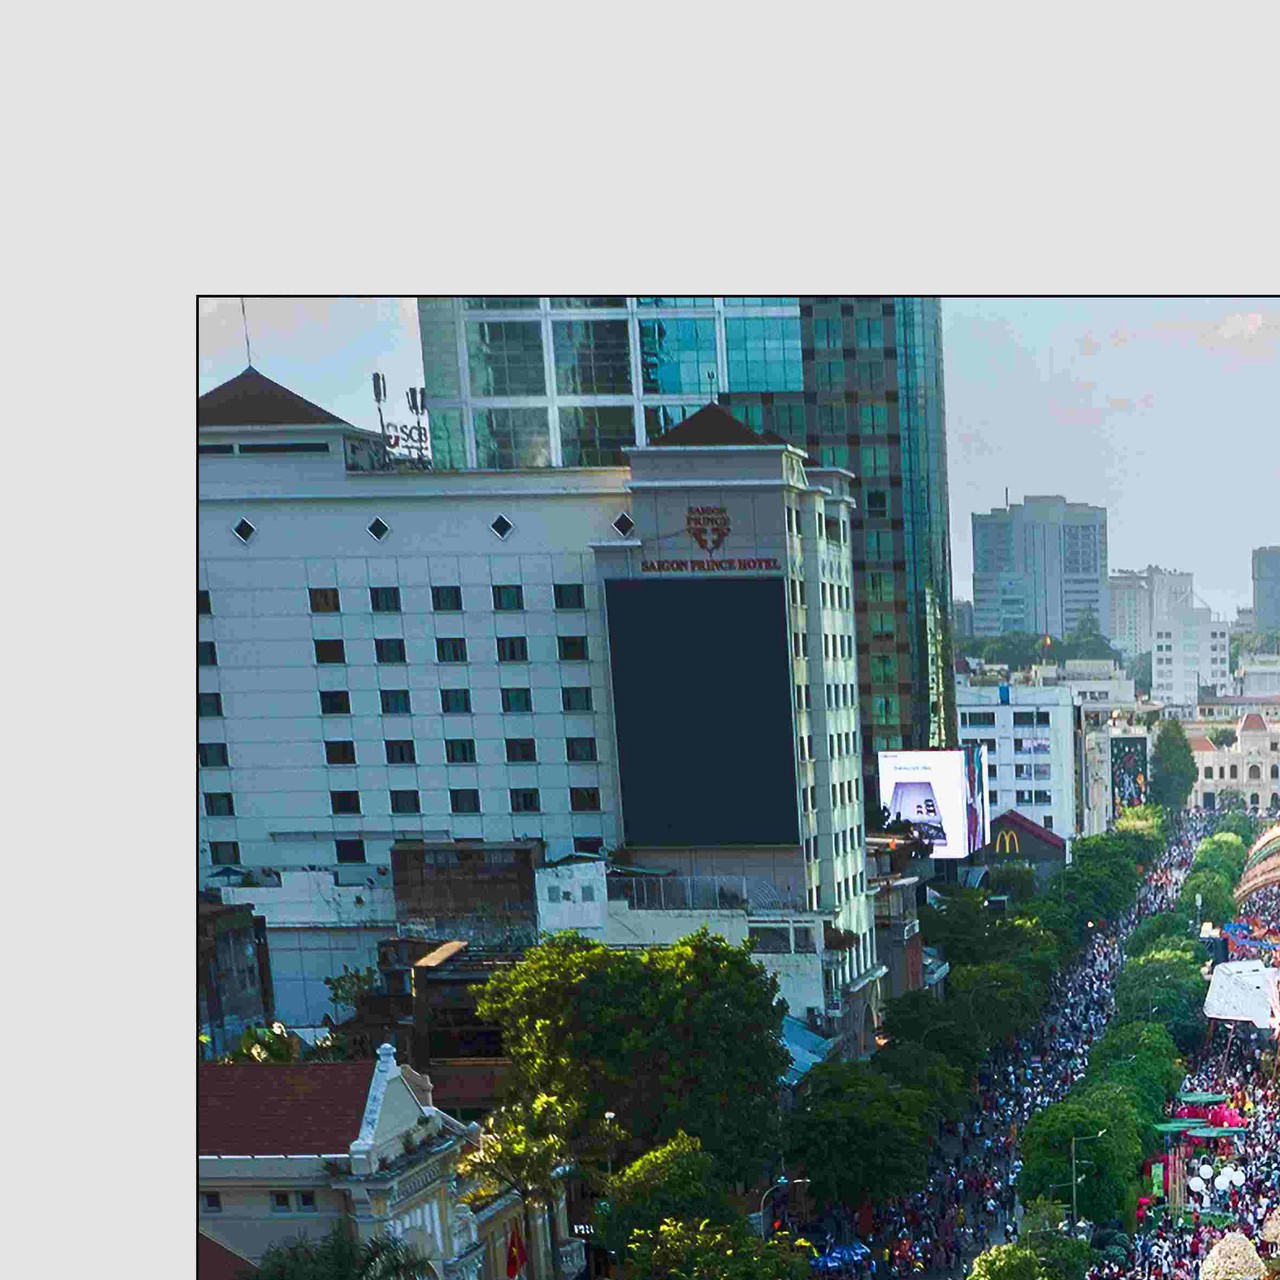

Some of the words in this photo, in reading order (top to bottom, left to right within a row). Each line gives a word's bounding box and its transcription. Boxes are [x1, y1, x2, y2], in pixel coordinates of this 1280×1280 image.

[641, 559, 688, 572] SAIGON
[690, 559, 736, 572] PRINCE
[738, 558, 781, 571] HOTEL
